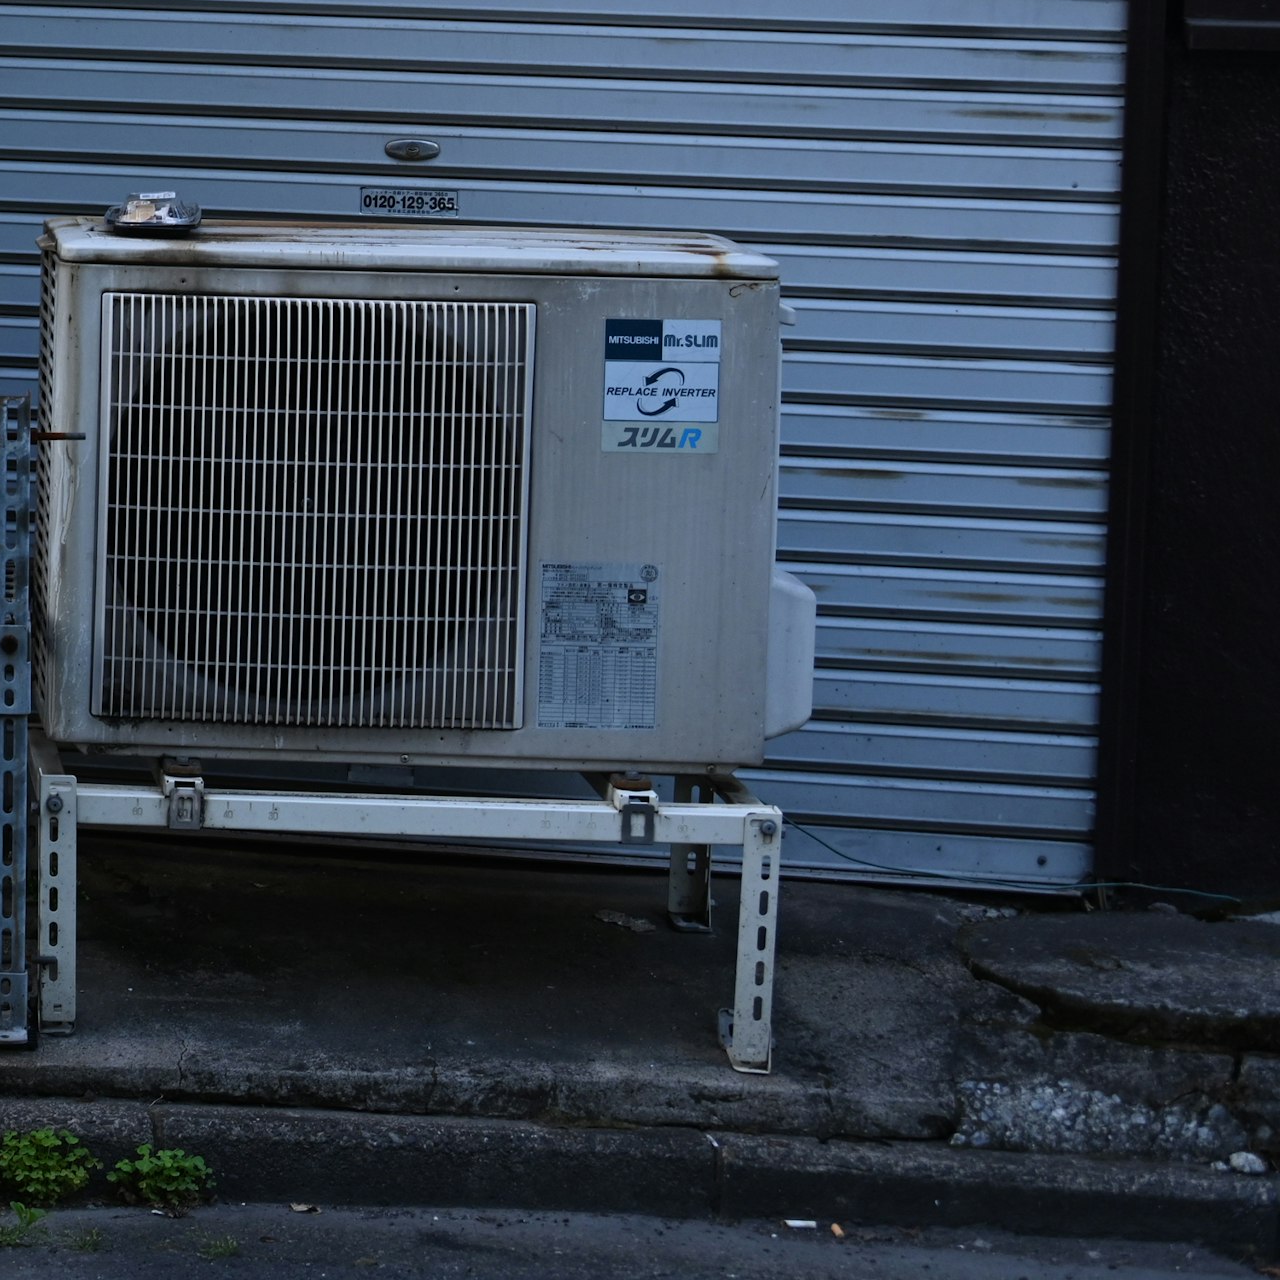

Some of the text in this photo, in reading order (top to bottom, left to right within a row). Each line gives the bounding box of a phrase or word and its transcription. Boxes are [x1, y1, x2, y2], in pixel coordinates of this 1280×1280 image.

[363, 195, 455, 210] 0120-129-365
[608, 336, 659, 345] MITSUBISHI
[606, 387, 716, 398] REPLACE INVERTER
[617, 427, 702, 449] スリムR
